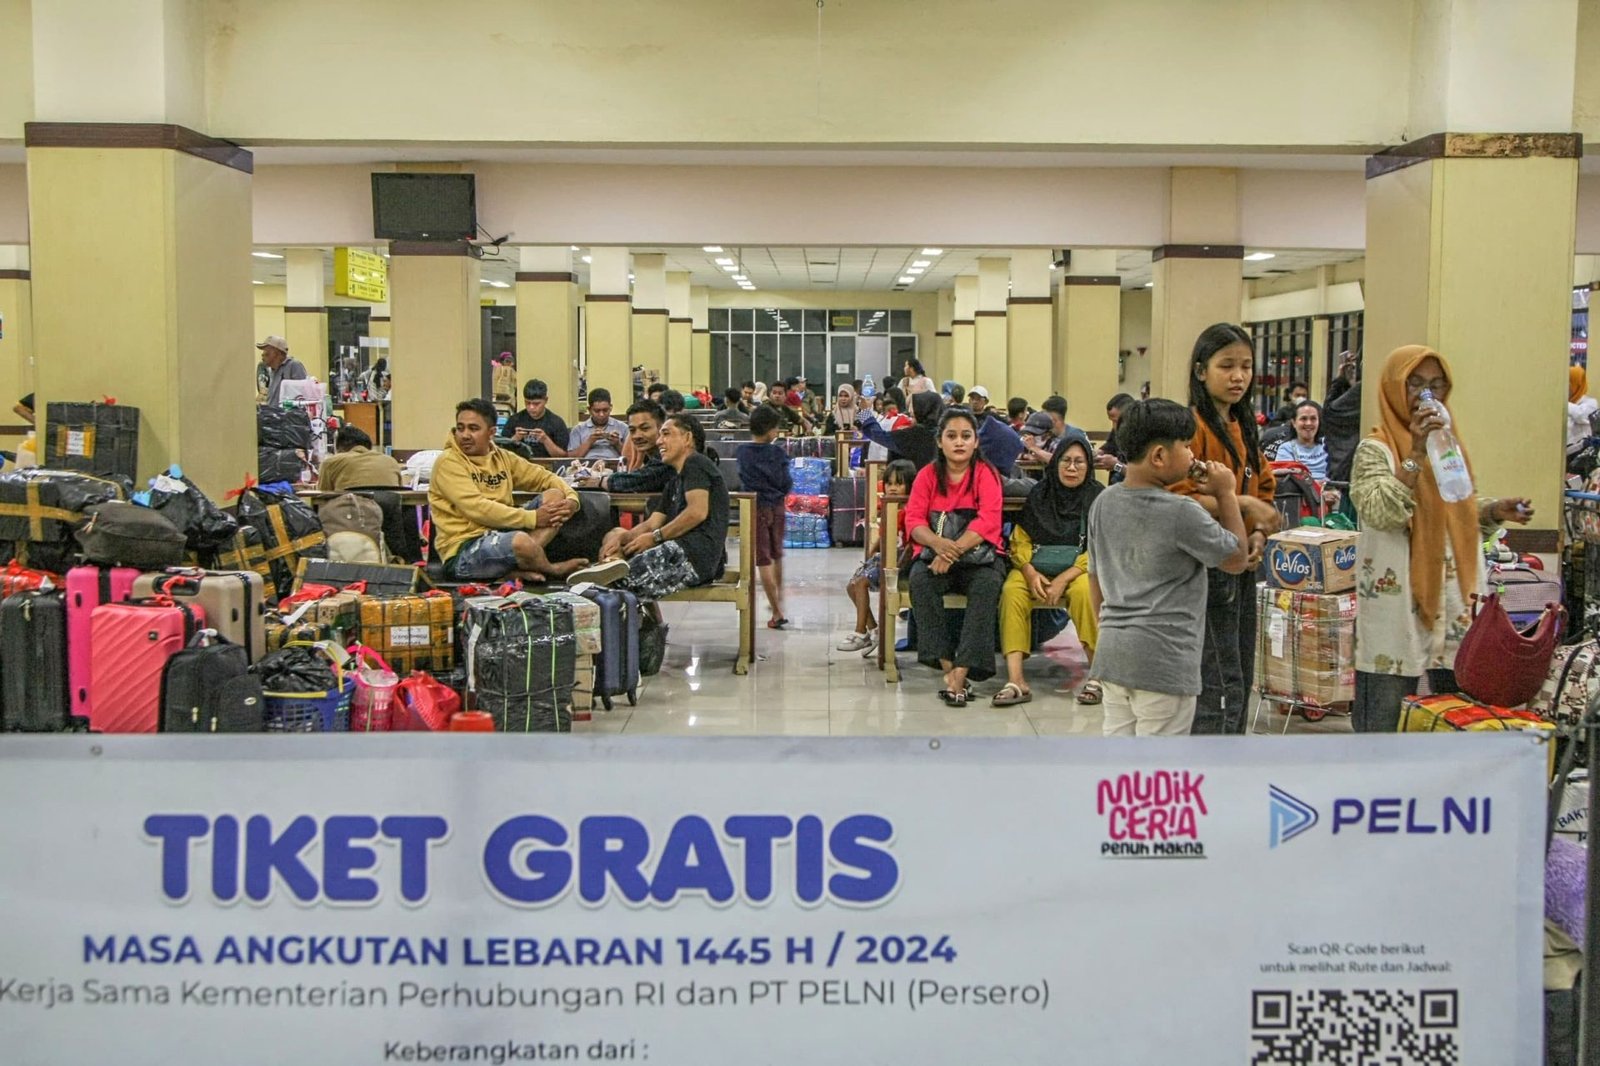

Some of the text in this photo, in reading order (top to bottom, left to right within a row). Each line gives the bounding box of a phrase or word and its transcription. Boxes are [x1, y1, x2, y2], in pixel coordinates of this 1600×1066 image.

[1275, 552, 1310, 575] LeVios
[1336, 546, 1357, 565] LeVio
[1332, 797, 1491, 834] PELNI
[144, 814, 900, 903] TIKET GRATIS
[1153, 842, 1203, 855] Makna
[83, 931, 957, 967] MASA ANGKUTAN LEBARAN 1445 H / 2024
[1288, 943, 1317, 954] Scan
[1381, 943, 1424, 955] berikut
[1260, 962, 1296, 972] untuk
[1300, 962, 1345, 972] melihat
[1350, 962, 1378, 972] Rute
[1381, 962, 1404, 972] dan
[0, 977, 1049, 1013] Kerja Sama Kementerian Perhubungan RI dan PT PELNI (Persero)
[384, 1041, 579, 1065] Keberangkatan
[586, 1039, 635, 1060] dari
